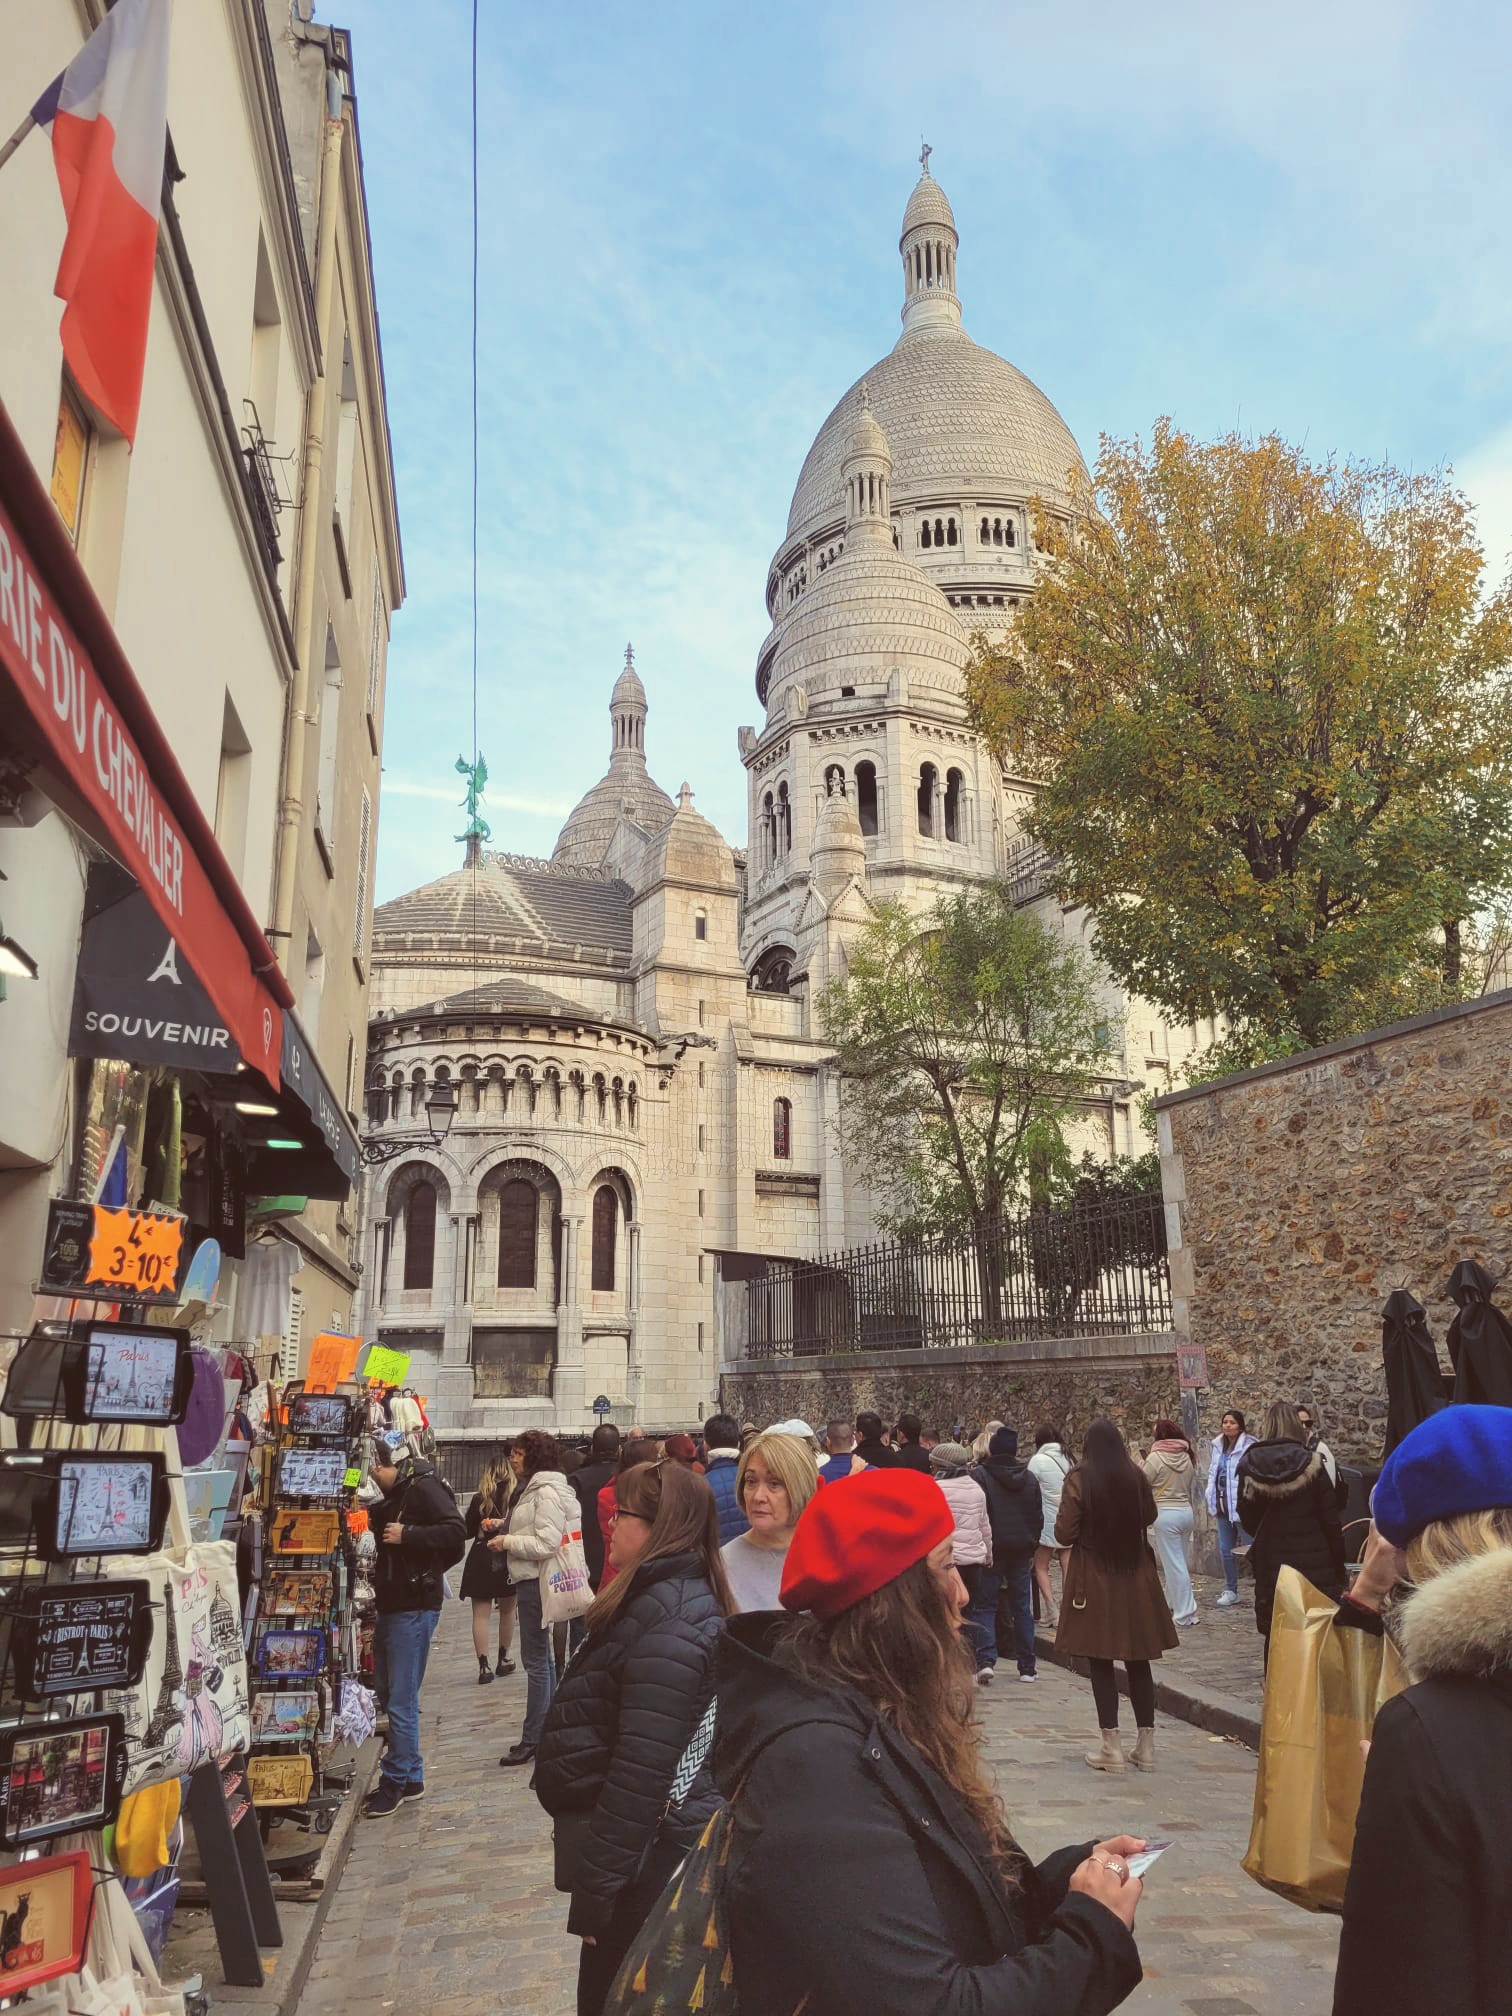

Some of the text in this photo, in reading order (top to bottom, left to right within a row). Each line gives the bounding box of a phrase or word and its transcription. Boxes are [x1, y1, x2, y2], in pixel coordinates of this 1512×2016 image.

[49, 615, 86, 754] DU
[92, 697, 183, 917] CHEVALIER
[85, 1011, 230, 1048] SOUVENIR
[127, 1219, 154, 1249] 4€
[553, 1578, 584, 1594] POWER
[89, 1624, 109, 1640] PARIS
[115, 1754, 128, 1783] PARIS
[0, 1775, 9, 1806] PARIS
